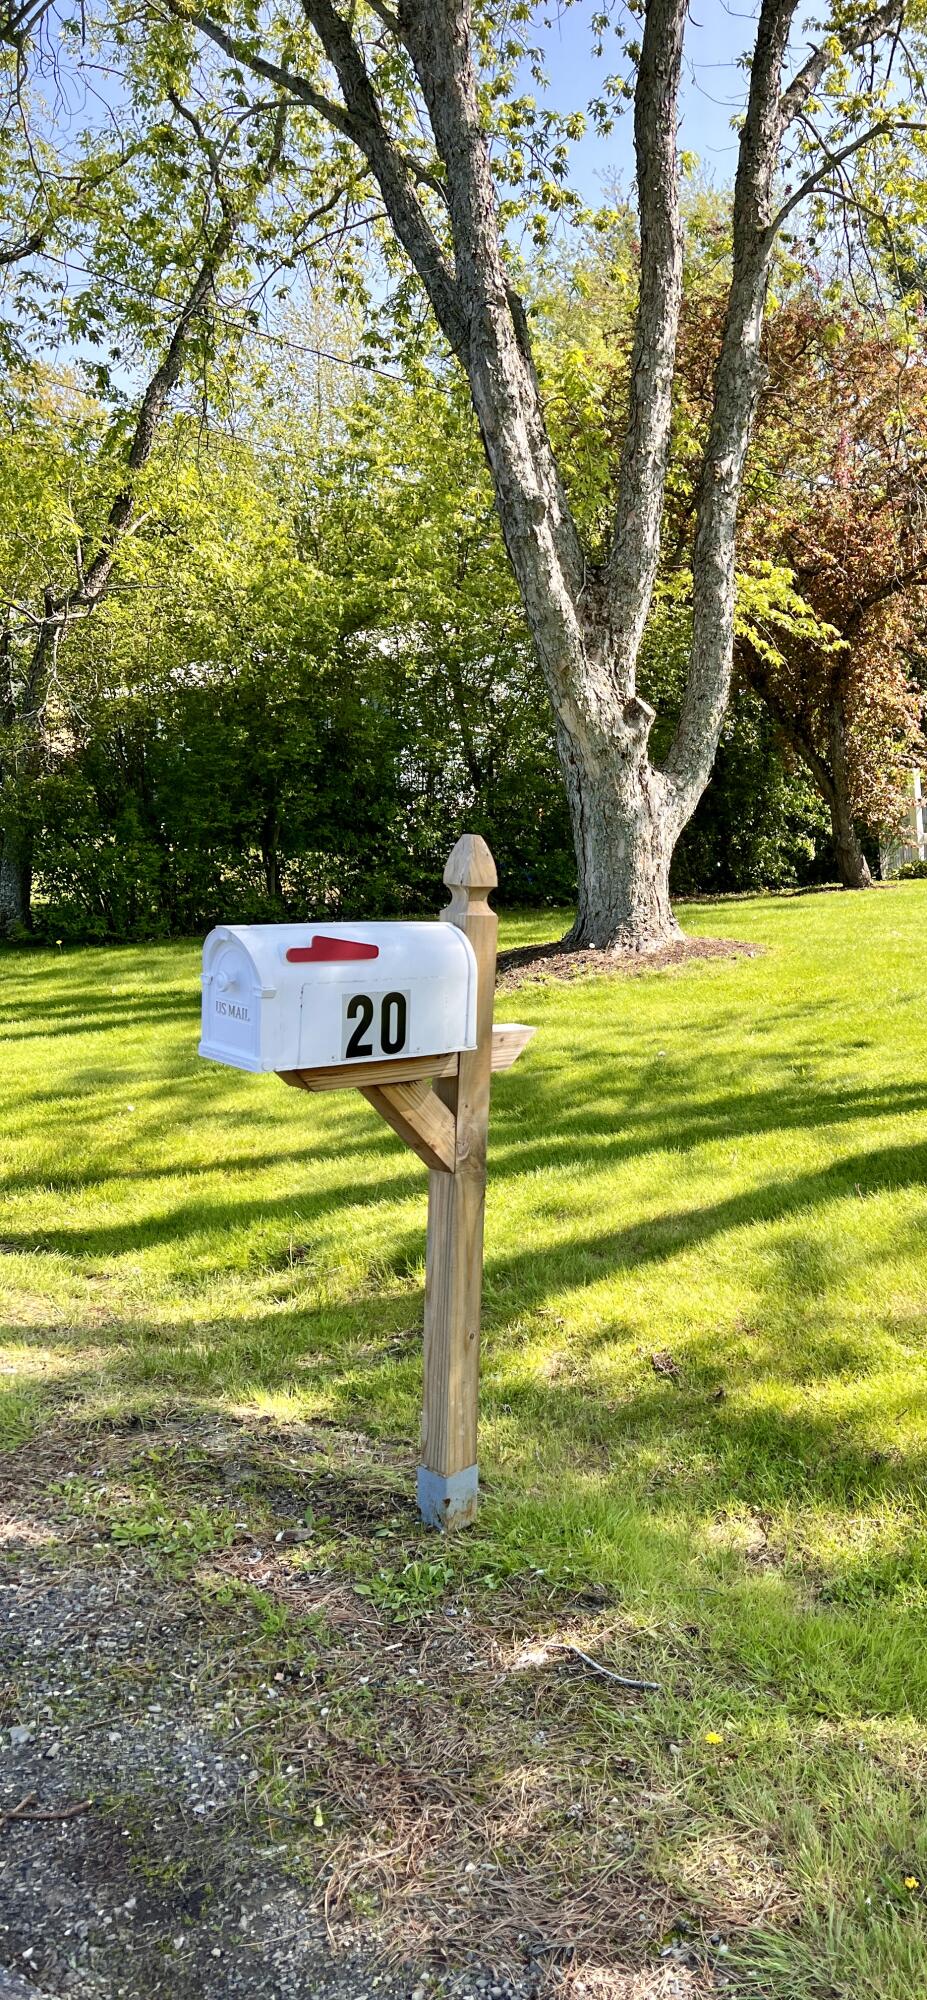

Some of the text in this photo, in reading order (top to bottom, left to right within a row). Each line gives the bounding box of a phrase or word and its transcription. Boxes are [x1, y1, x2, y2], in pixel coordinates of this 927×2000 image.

[215, 1000, 250, 1021] US MAIL
[345, 991, 406, 1058] 20
